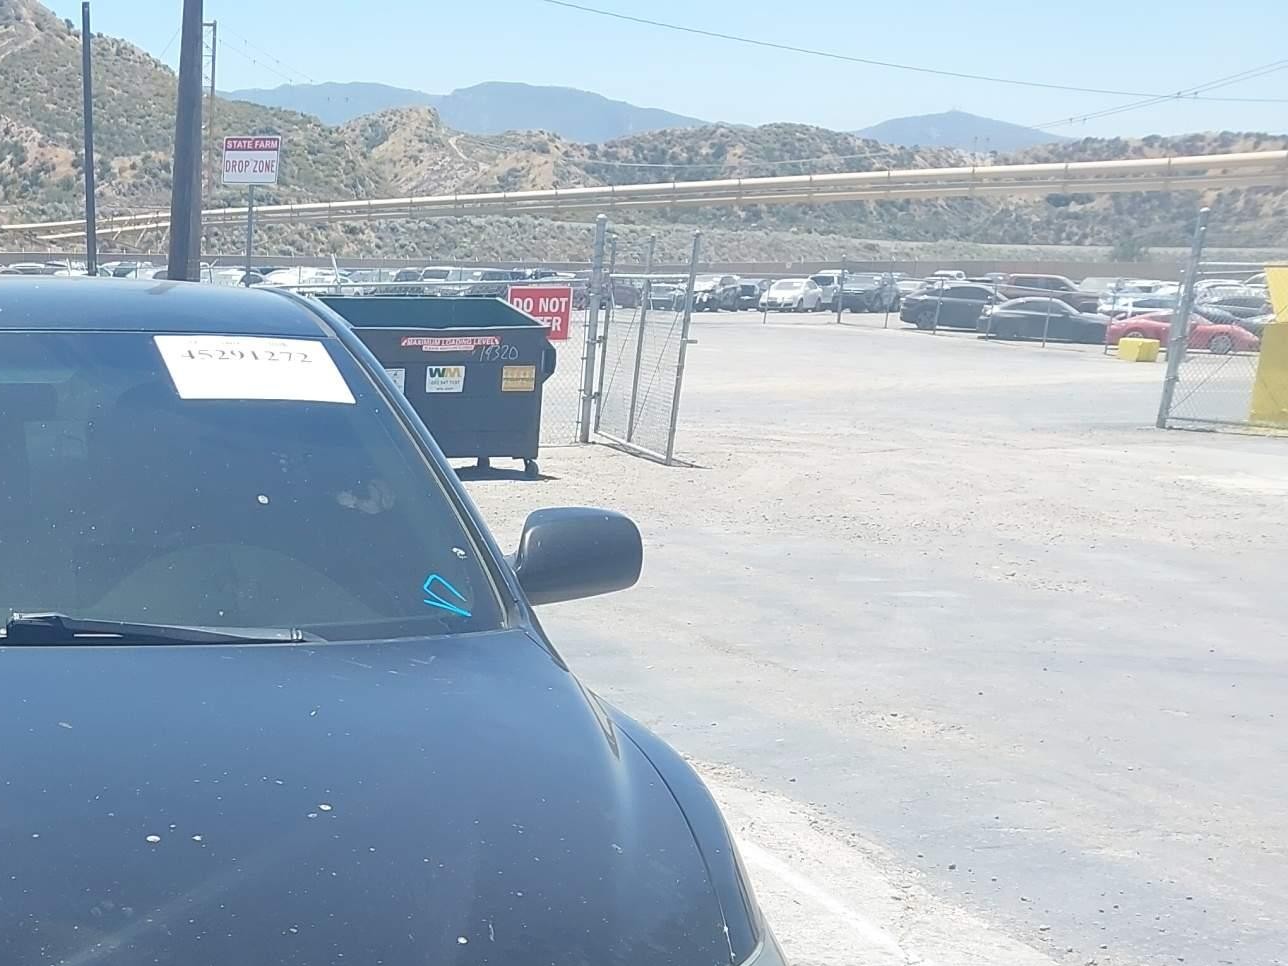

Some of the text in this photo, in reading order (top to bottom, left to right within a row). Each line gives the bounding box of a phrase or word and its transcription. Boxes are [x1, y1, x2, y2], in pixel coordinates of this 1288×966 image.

[226, 140, 278, 149] STATE FARM
[225, 160, 276, 173] DROP ZONE
[513, 297, 569, 313] DO NOT
[407, 337, 494, 346] MAXIMUM LOADING LEVEL
[180, 349, 313, 363] 45291272
[429, 367, 463, 378] WM
